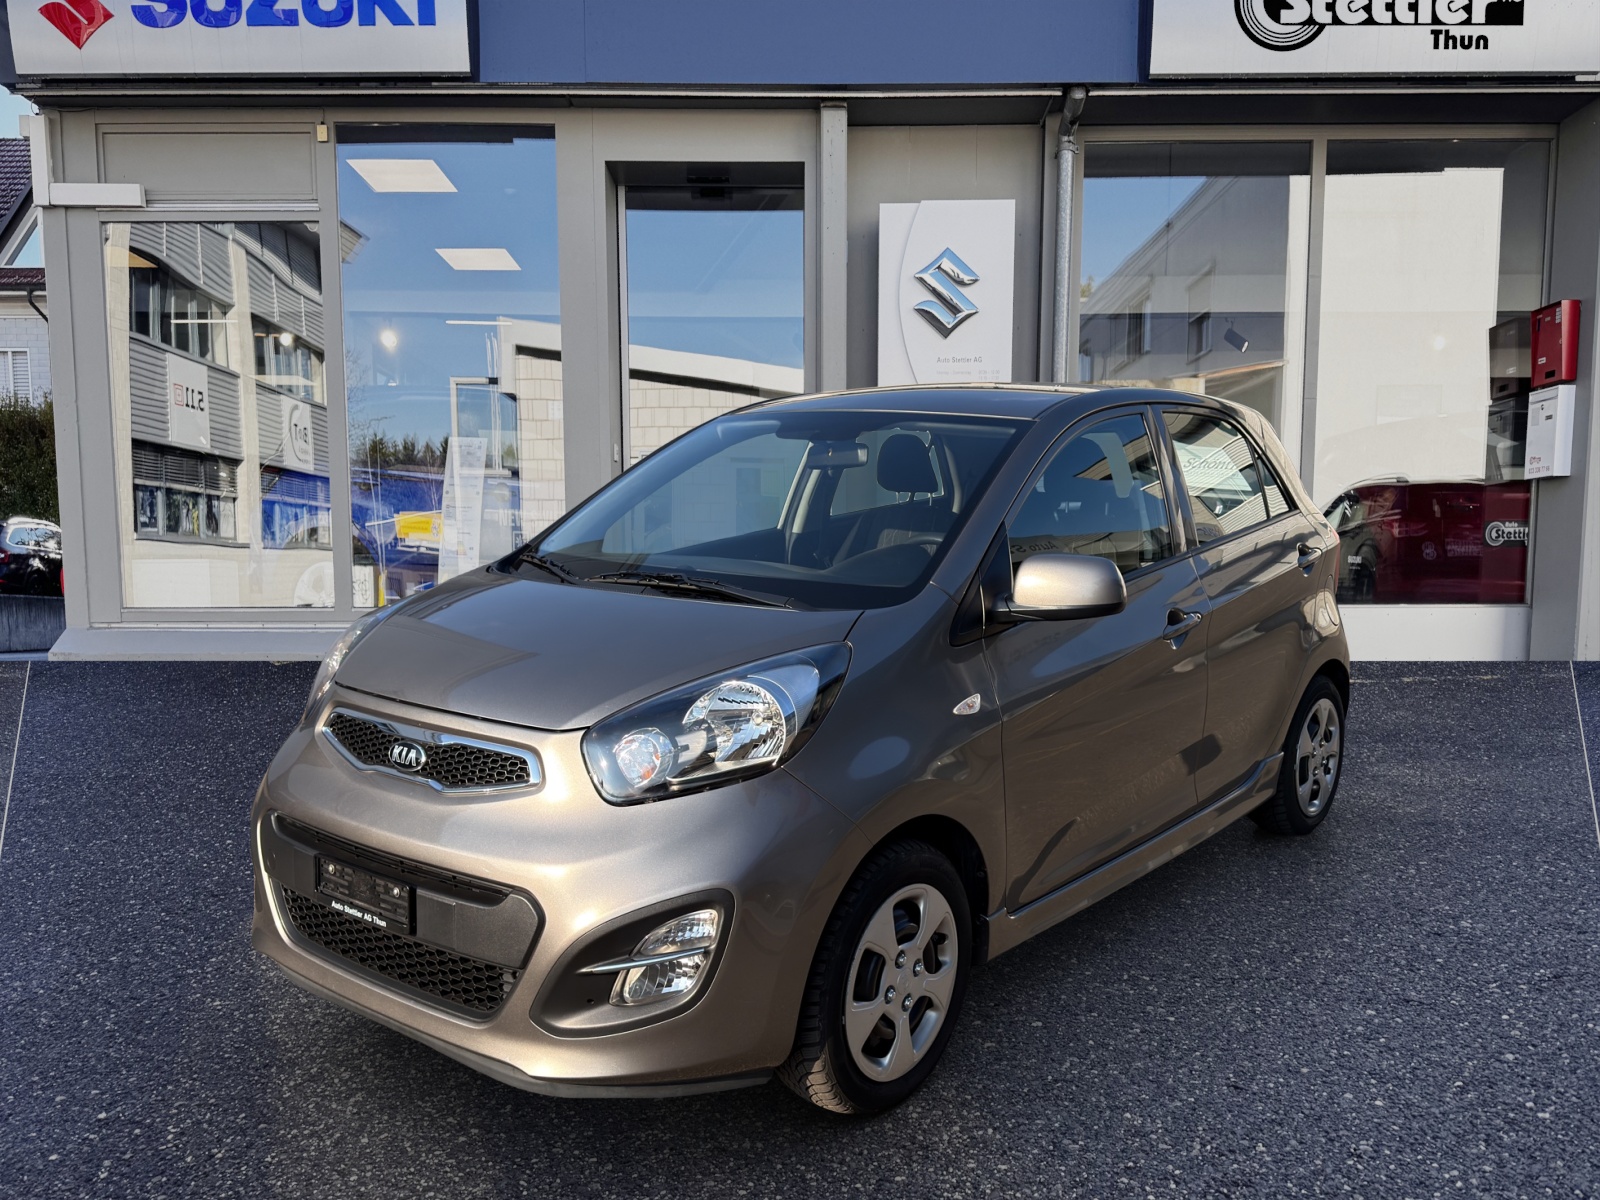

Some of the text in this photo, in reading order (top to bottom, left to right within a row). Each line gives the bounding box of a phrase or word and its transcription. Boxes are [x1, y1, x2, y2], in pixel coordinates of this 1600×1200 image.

[1430, 29, 1489, 50] Thun
[937, 356, 950, 364] Auto
[951, 356, 972, 364] Stettler
[391, 744, 417, 767] KIA
[331, 900, 387, 928] Auto Stettler AG Thun
